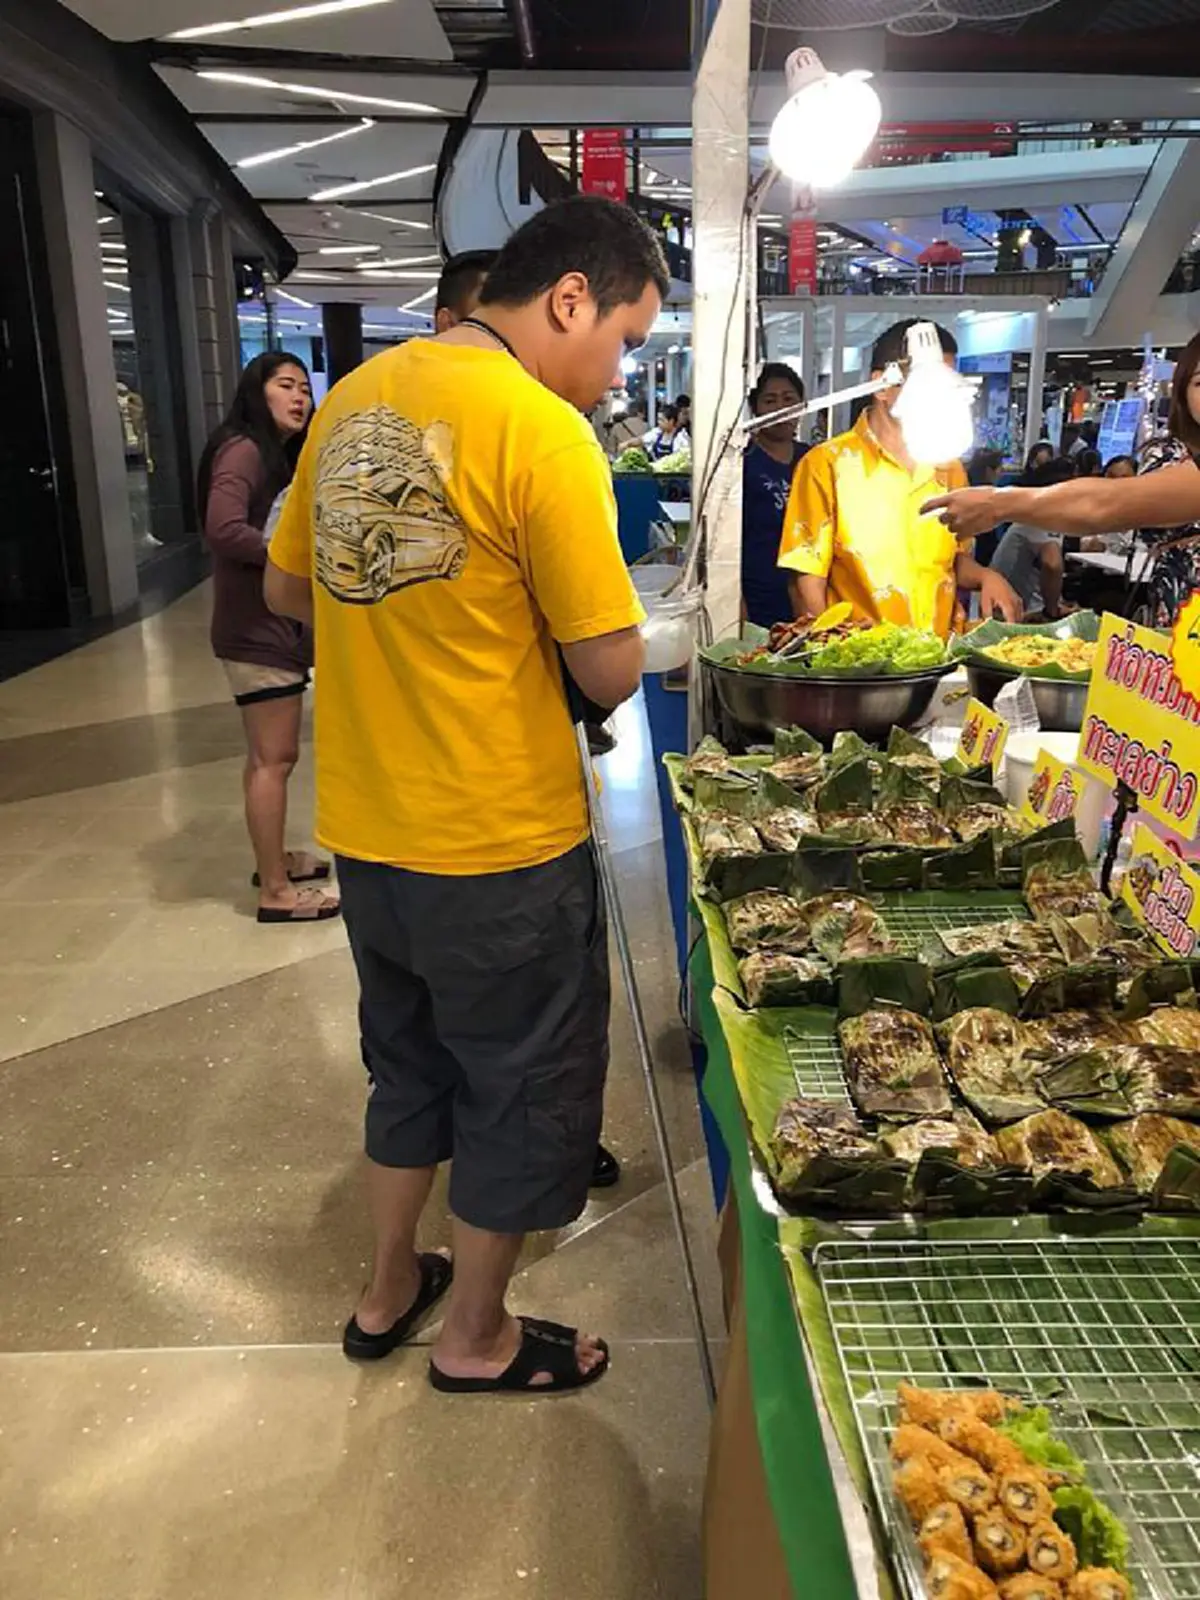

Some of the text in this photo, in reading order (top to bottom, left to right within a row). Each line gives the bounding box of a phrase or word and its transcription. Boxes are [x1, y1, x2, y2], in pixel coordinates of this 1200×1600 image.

[1083, 714, 1198, 820] ทะเลย่าง
[1161, 863, 1193, 920] ปลา
